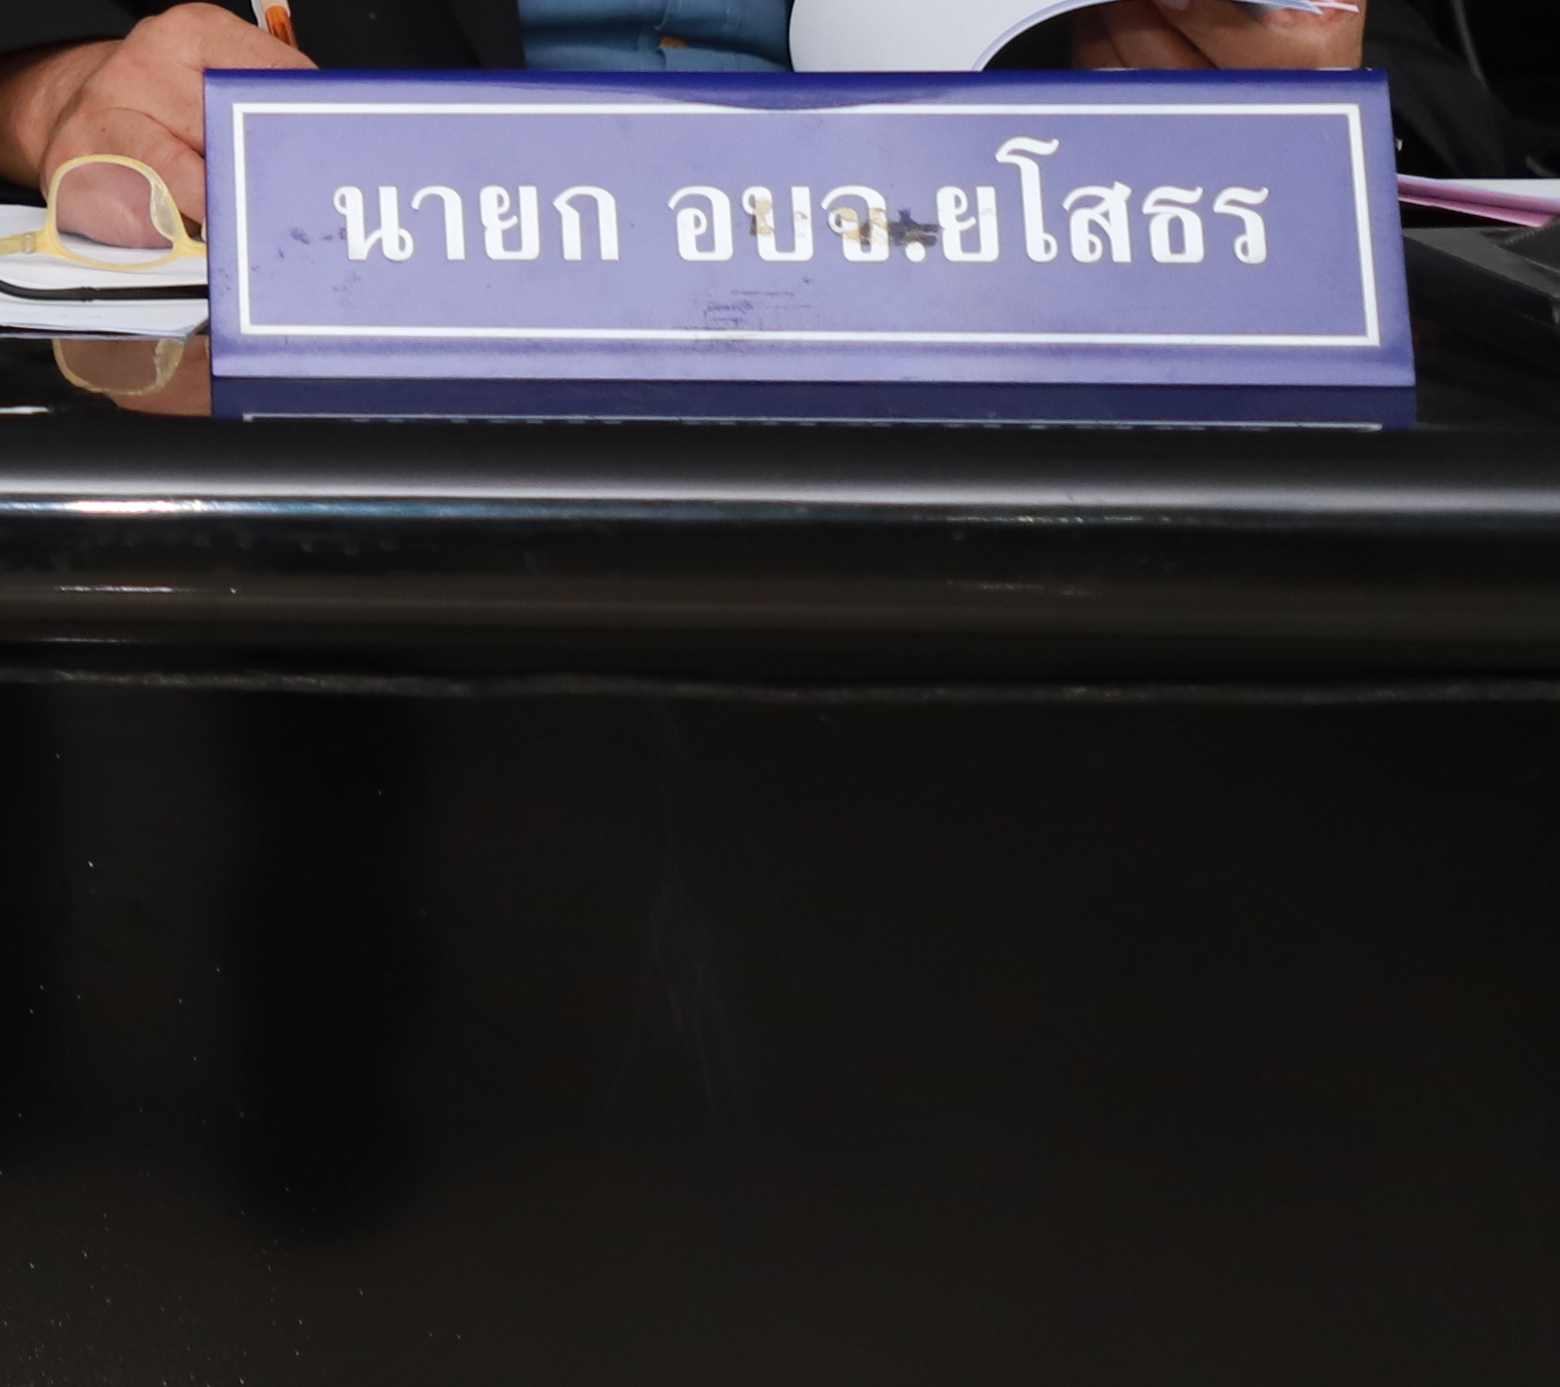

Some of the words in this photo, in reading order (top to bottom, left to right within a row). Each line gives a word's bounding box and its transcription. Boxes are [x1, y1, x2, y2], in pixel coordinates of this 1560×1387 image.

[333, 183, 621, 263] นายก
[666, 136, 1270, 265] อบจ.ยโสธร
